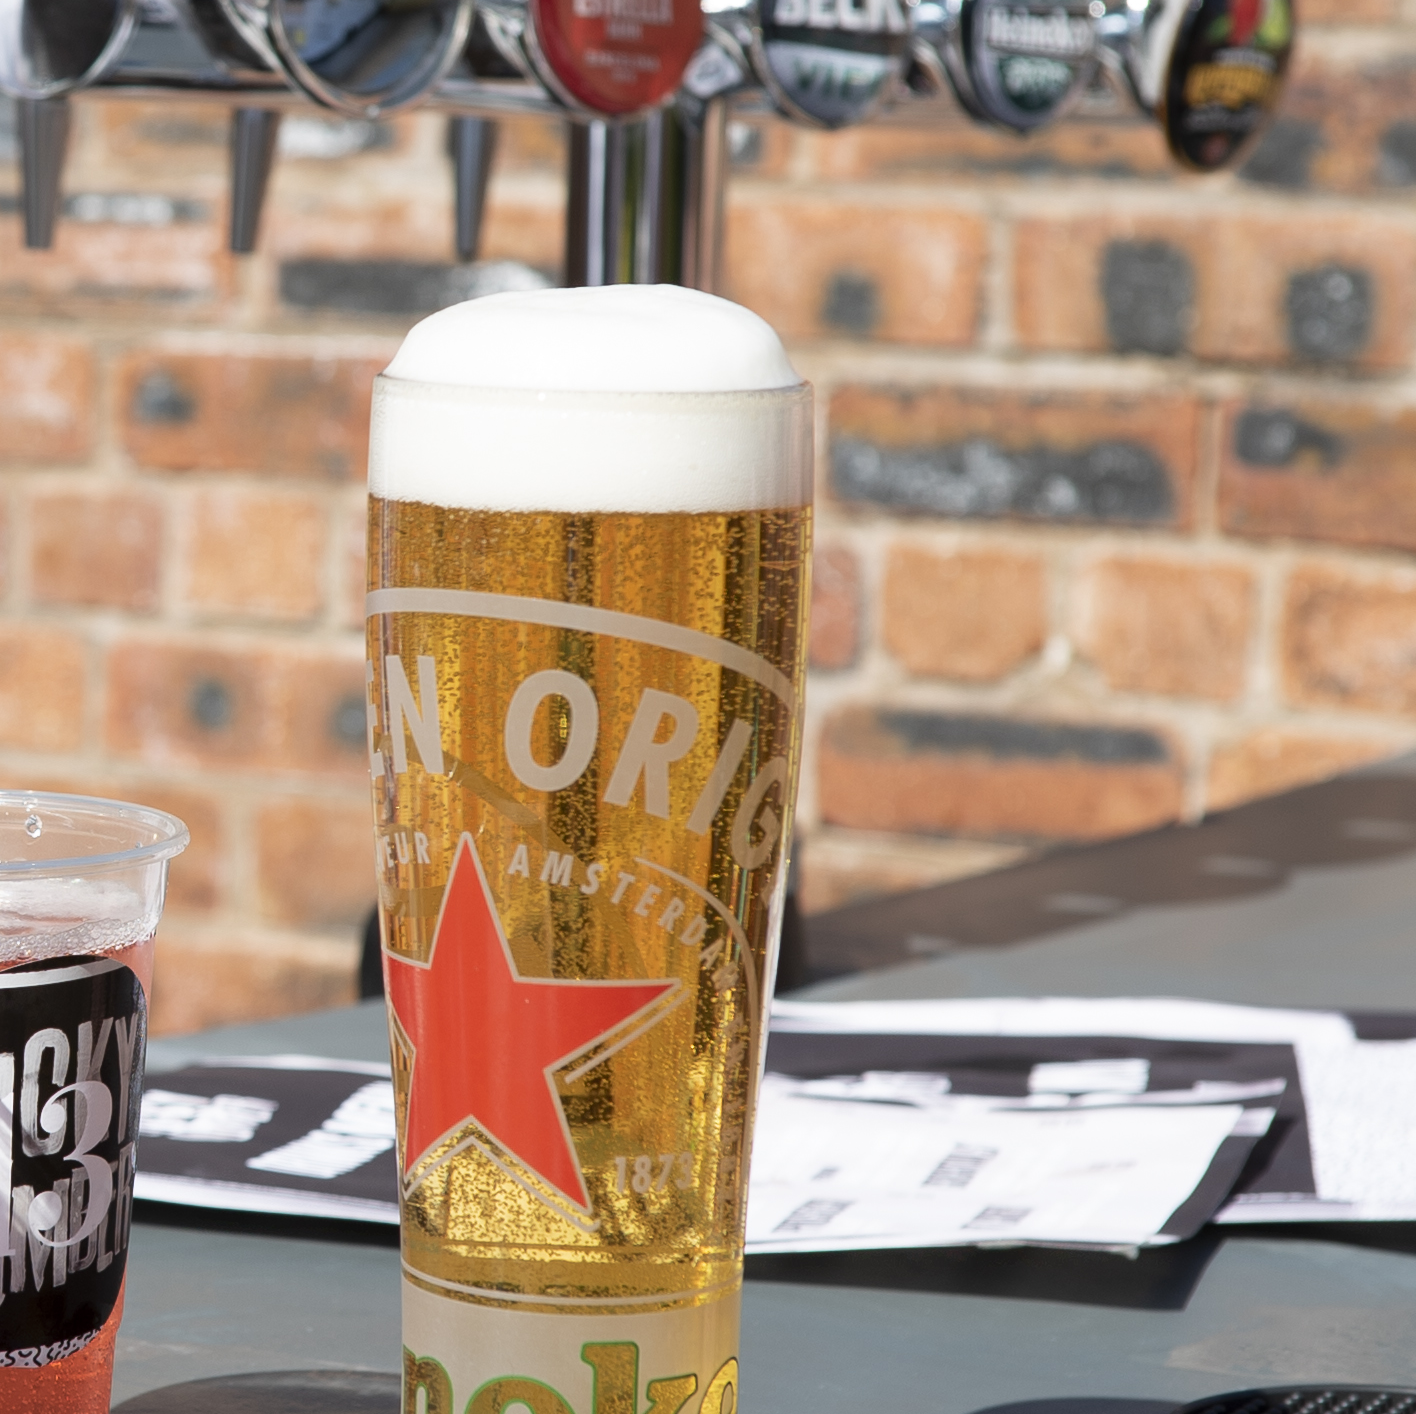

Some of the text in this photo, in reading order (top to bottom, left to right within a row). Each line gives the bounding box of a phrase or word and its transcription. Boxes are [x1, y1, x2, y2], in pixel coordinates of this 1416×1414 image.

[502, 668, 787, 909] ORIG
[507, 843, 739, 990] AMSTERDAM
[614, 1151, 694, 1195] 1873
